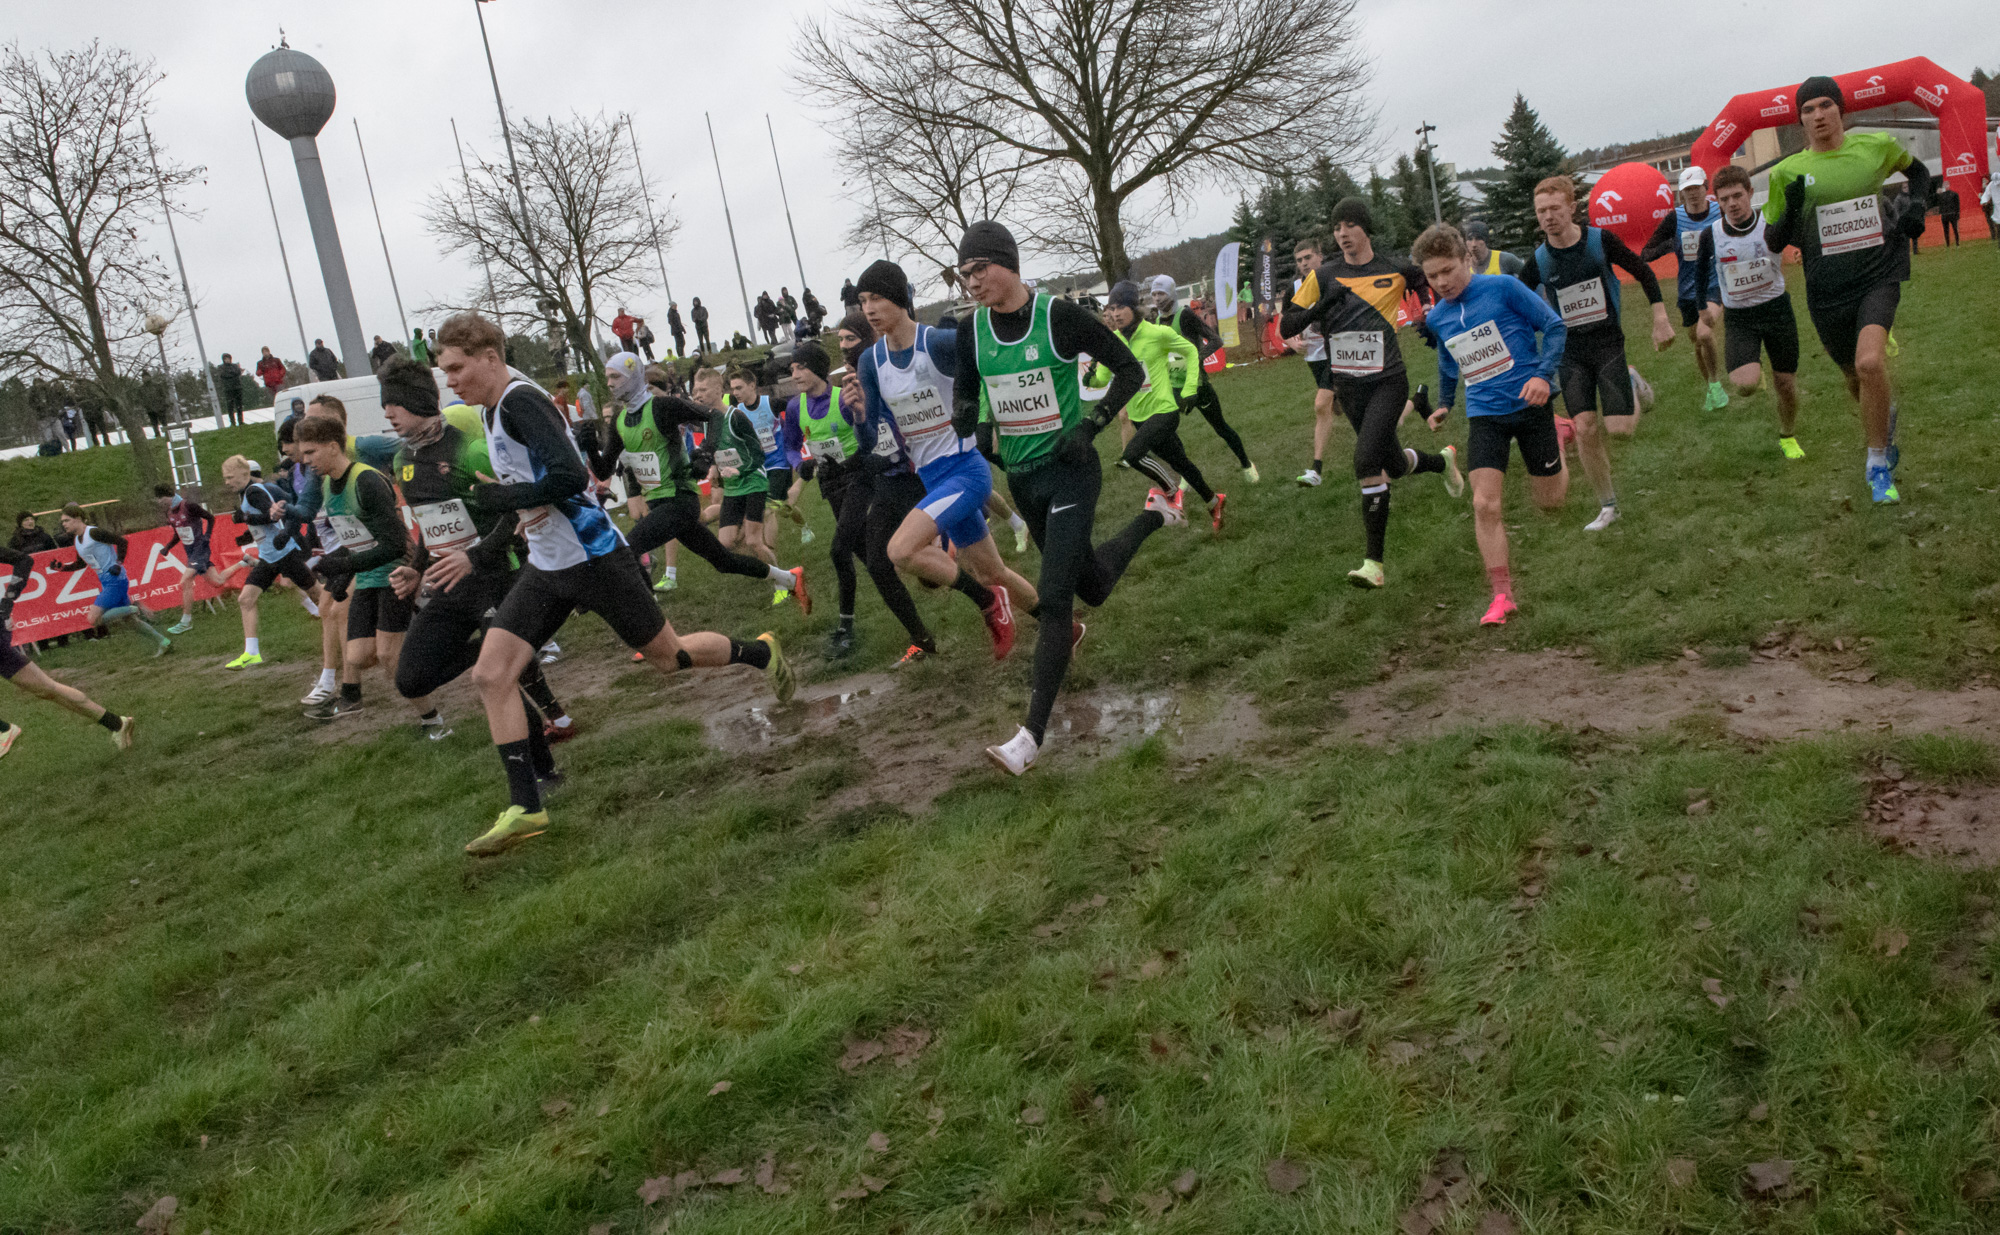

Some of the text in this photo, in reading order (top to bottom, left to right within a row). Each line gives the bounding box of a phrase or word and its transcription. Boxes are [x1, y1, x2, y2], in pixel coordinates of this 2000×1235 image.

[1855, 86, 1885, 99] ORLEN
[1915, 87, 1943, 106] ORLEN
[1761, 106, 1788, 116] ORLEN
[1714, 124, 1736, 148] ORLEN
[1947, 165, 1977, 177] ORLEN
[1853, 198, 1874, 211] 162
[1595, 214, 1628, 226] ORLEN
[1821, 216, 1880, 237] GRZEGRZÓŁKA
[1749, 259, 1767, 270] 261
[1262, 255, 1272, 301] drzonków
[1734, 273, 1764, 287] ZELEK
[1579, 281, 1598, 293] 347
[1563, 297, 1599, 314] BREZA
[1358, 334, 1378, 343] 541
[1471, 326, 1493, 342] 548
[1336, 350, 1376, 360] SIMLAT
[1018, 371, 1045, 388] 524
[912, 388, 934, 403] 544
[998, 394, 1050, 413] JANICKI
[877, 426, 887, 435] 15
[820, 440, 835, 449] 289
[876, 438, 896, 452] CZAK
[439, 502, 460, 515] 298
[424, 517, 464, 539] KOPEĆ
[15, 615, 51, 629] OLSKI
